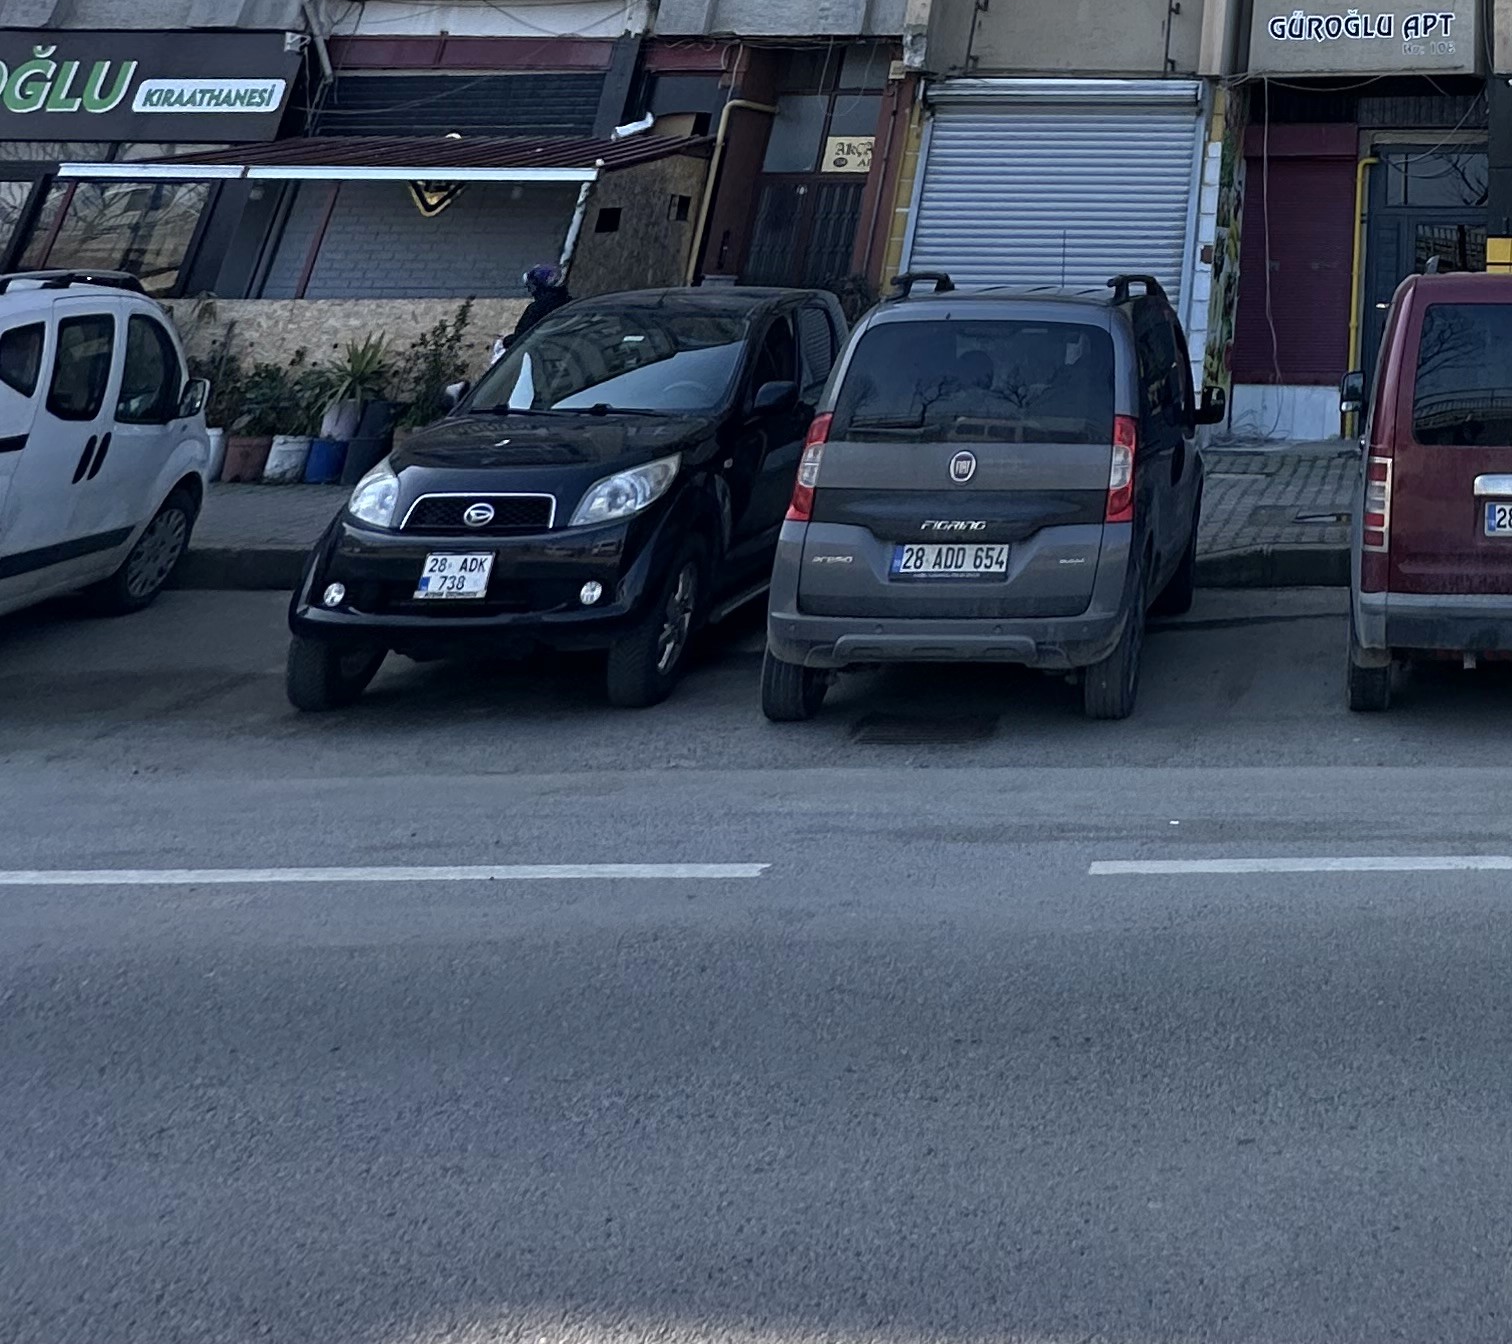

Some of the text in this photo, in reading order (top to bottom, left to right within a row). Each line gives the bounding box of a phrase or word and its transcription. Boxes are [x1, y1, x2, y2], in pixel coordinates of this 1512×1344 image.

[1268, 9, 1456, 43] GÜROĞLU APT
[0, 45, 138, 113] ĞLU
[428, 557, 488, 573] 28 ADK
[902, 547, 1005, 570] 28 ADD 654
[438, 575, 466, 591] 738
